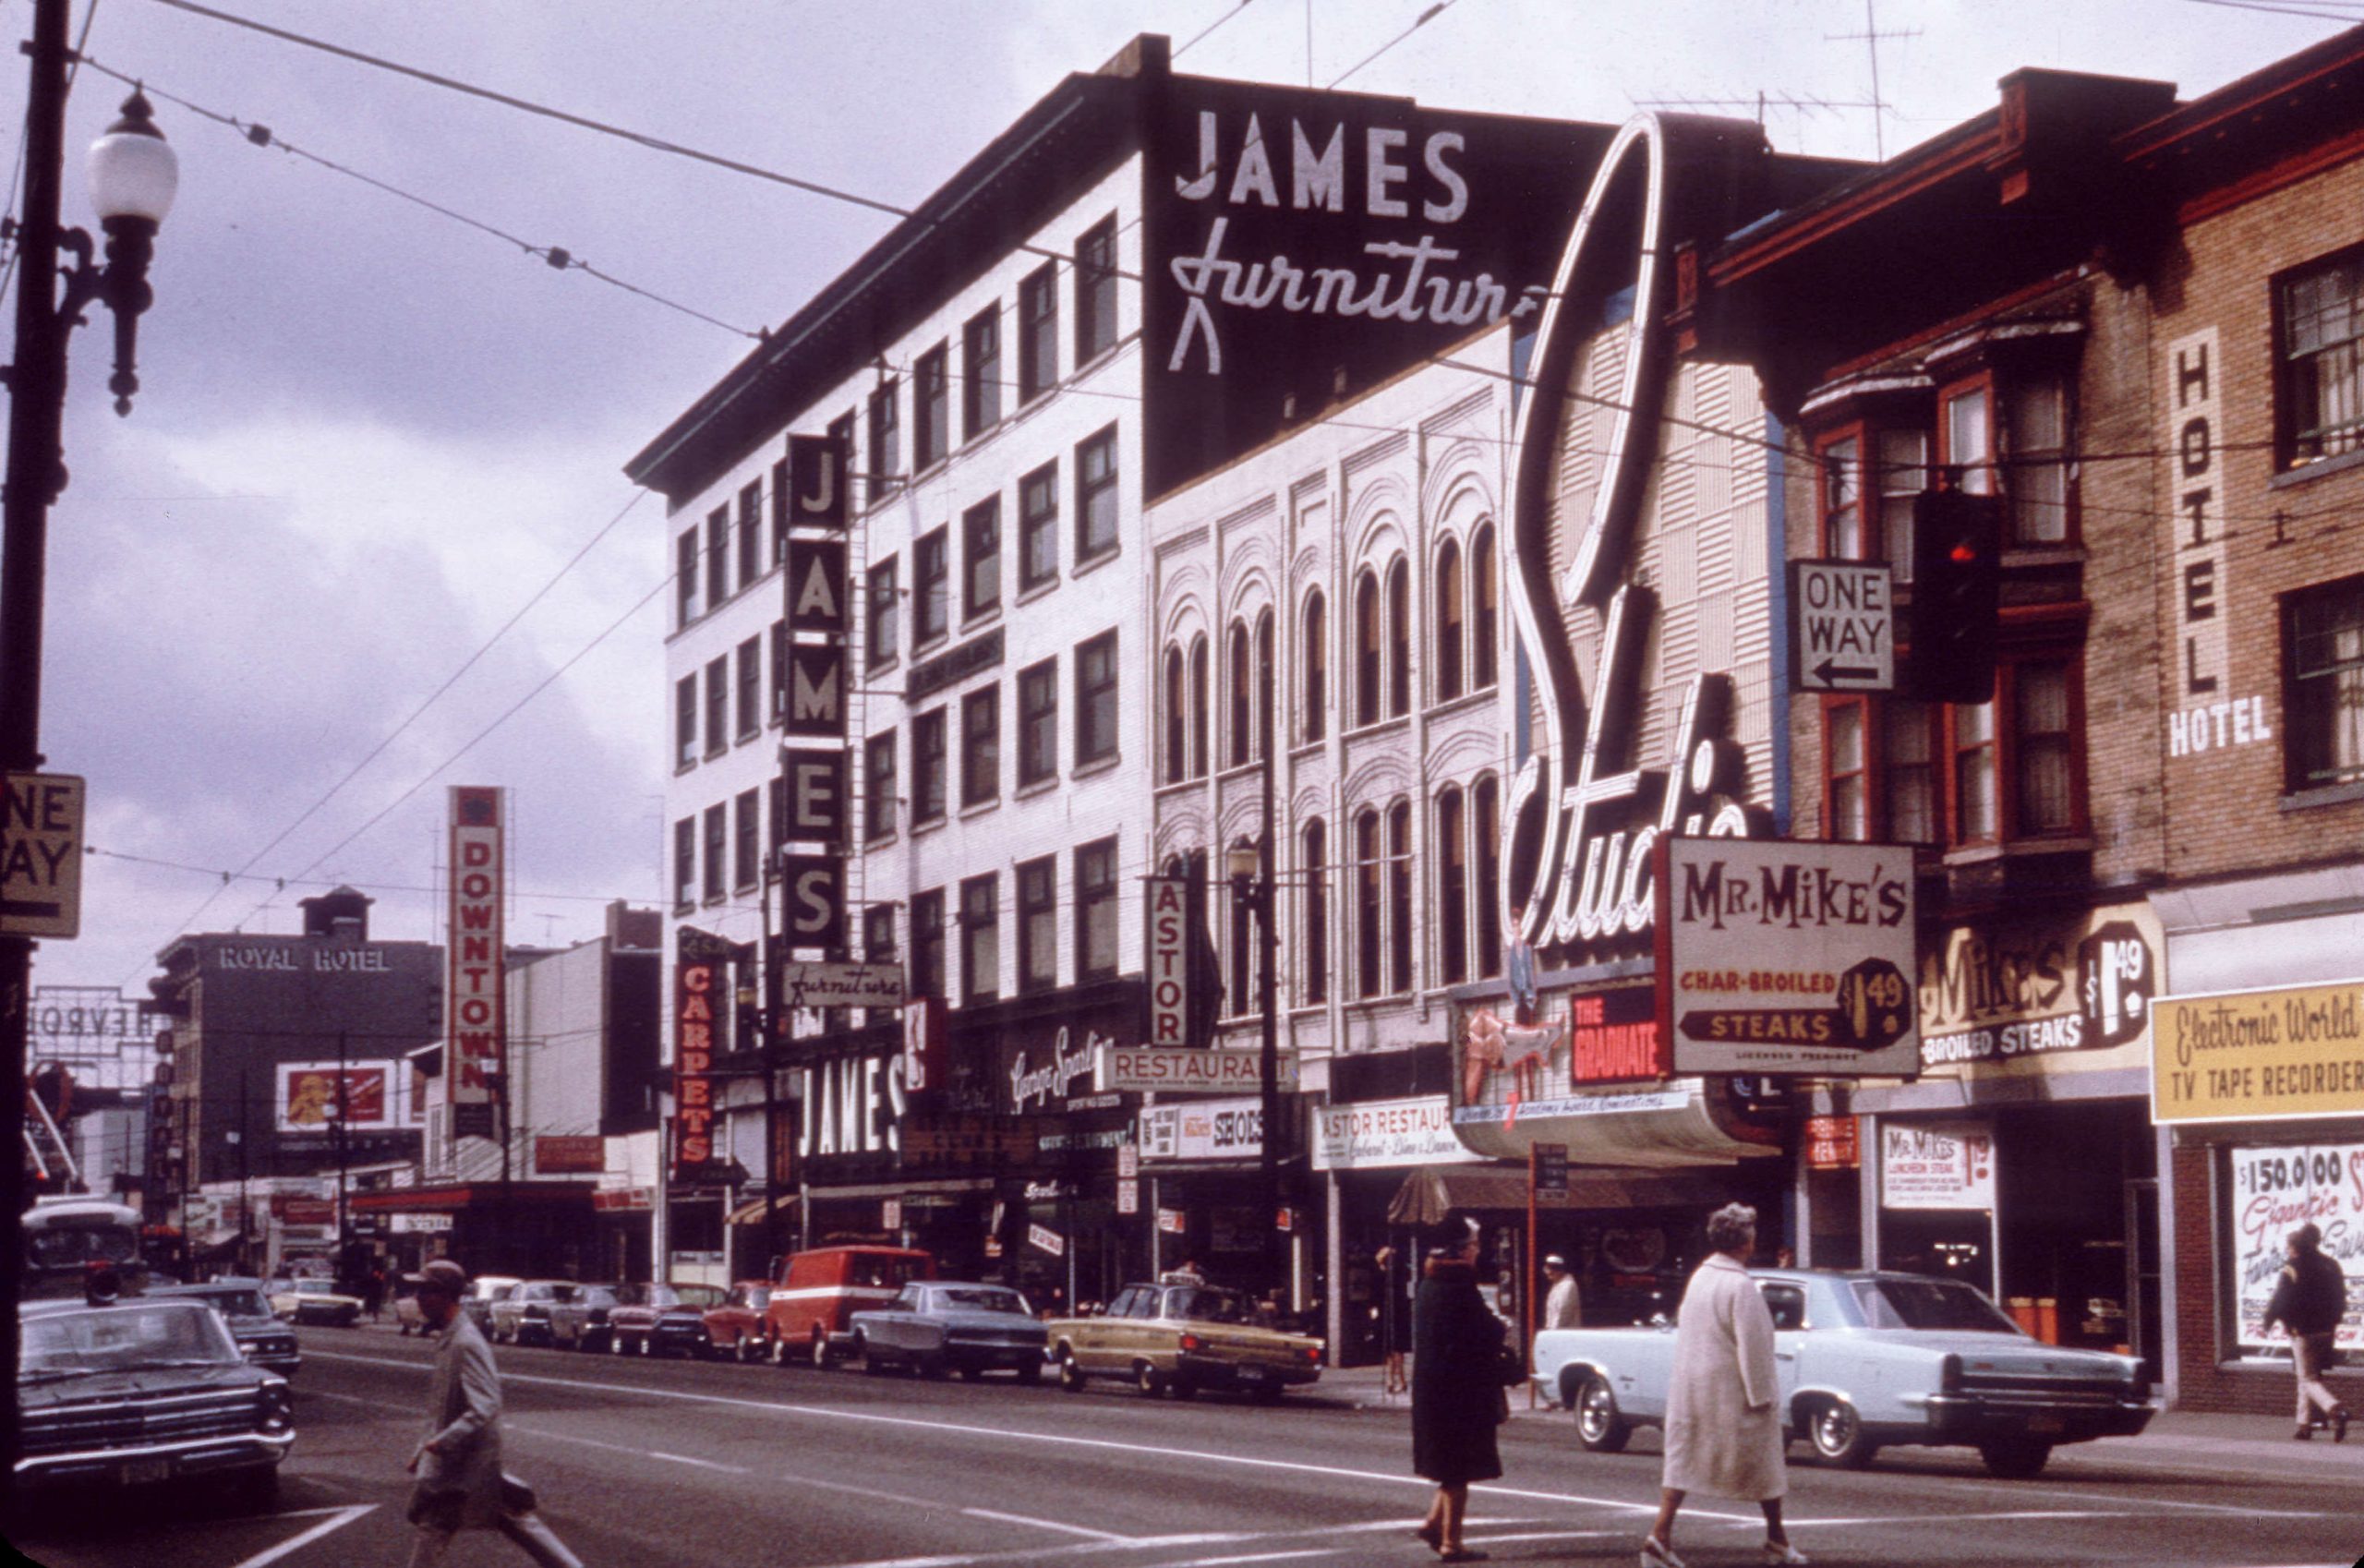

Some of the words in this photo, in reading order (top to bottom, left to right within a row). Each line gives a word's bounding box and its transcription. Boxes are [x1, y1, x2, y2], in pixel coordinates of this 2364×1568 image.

[1176, 111, 1469, 223] JAMES
[2177, 343, 2217, 695] HOTEL
[1808, 572, 1884, 611] ONE
[1808, 617, 1886, 655] WAY
[795, 451, 838, 932] JAMES
[2170, 696, 2272, 758] HOTEL
[3, 784, 71, 831] NE
[0, 838, 71, 887] AY
[220, 947, 297, 970] ROYAL
[314, 948, 391, 971] HOTEL
[463, 841, 492, 1091] DOWNTOWN
[1155, 884, 1182, 1042] ASTOR
[1680, 971, 1837, 995] CHAR-BROILED
[790, 965, 899, 1007] furniture
[1574, 998, 1603, 1025] THE
[1711, 1014, 1831, 1041] STEAKS
[2000, 1014, 2083, 1054] STEAKS
[2176, 1003, 2280, 1067] Electronic
[2286, 993, 2361, 1043] World
[684, 966, 713, 1162] CARPETS
[1116, 1055, 1292, 1079] RESTAURAT
[1574, 1021, 1658, 1080] GRADUATE
[797, 1051, 901, 1157] JAMES
[2172, 1071, 2196, 1102] TV
[2208, 1067, 2254, 1100] TAPE
[1323, 1111, 1372, 1139] ASTOR
[2242, 1188, 2339, 1250] Gigantic
